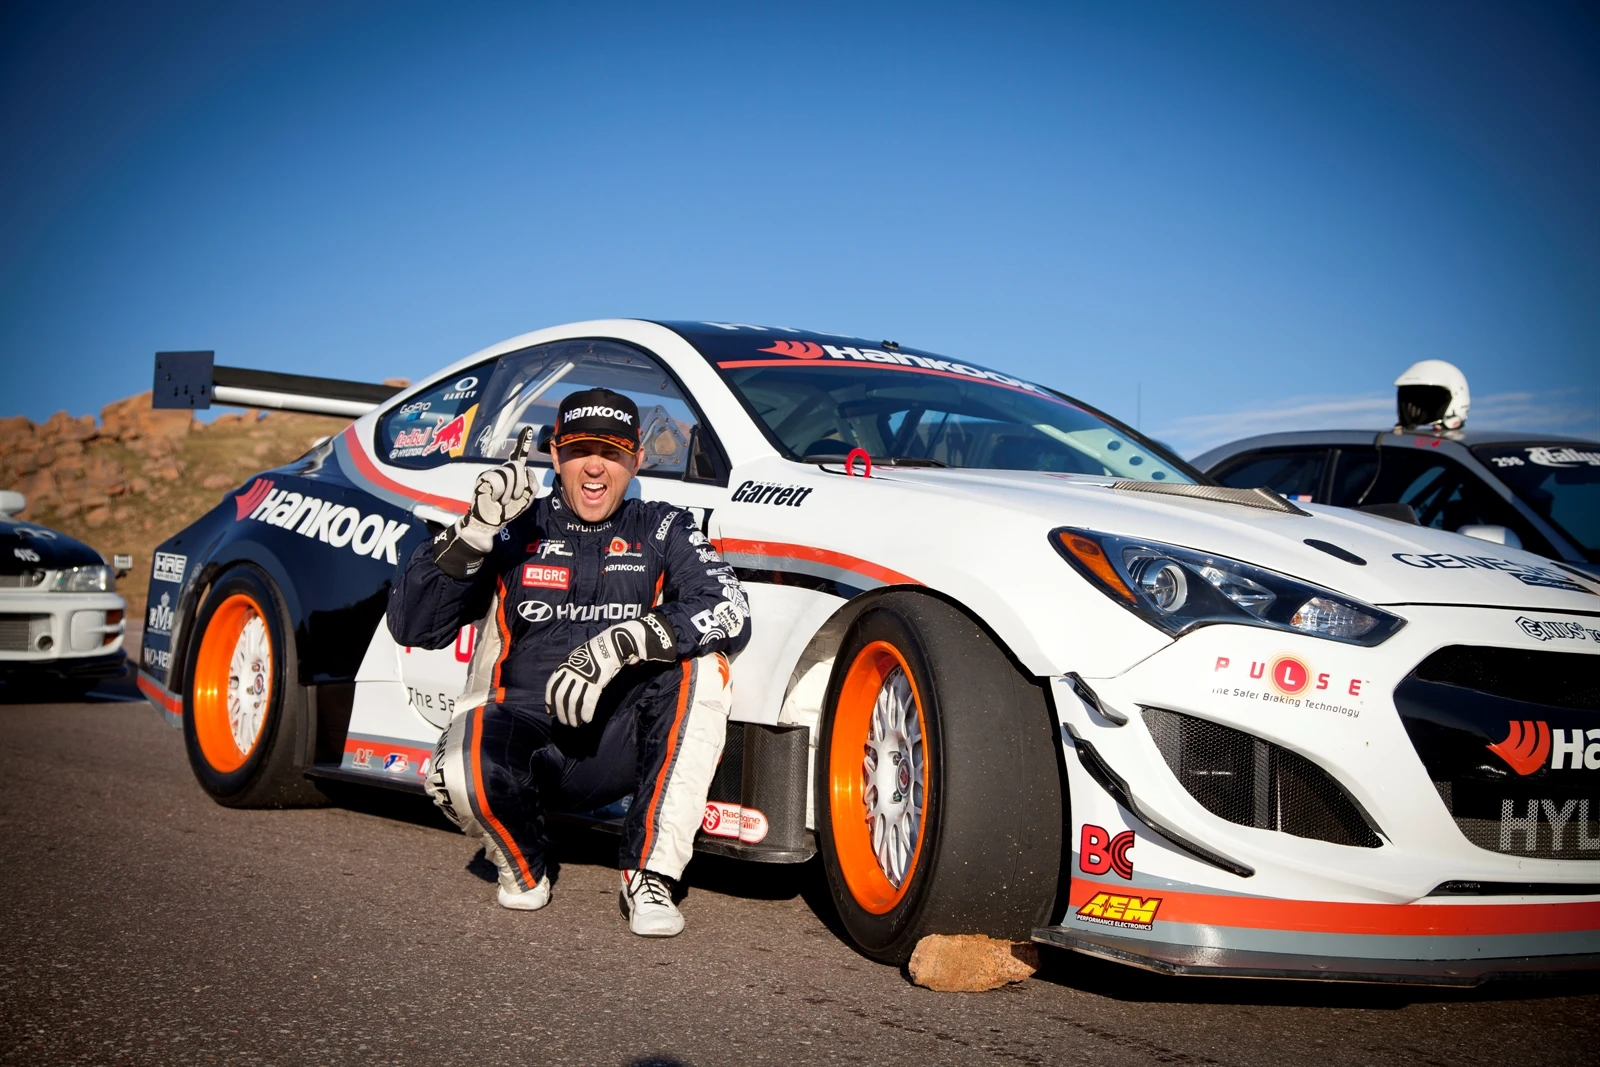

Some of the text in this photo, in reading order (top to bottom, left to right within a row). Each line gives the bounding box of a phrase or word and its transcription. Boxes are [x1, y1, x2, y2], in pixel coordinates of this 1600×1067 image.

[443, 391, 477, 401] OAKLEY
[400, 402, 431, 415] GoPro
[1491, 456, 1525, 467] 298
[731, 480, 813, 507] Garrett
[567, 520, 612, 533] HYUNDAI
[655, 510, 680, 541] sparco
[156, 554, 186, 576] HRE
[543, 568, 567, 582] GRC
[556, 603, 642, 622] HYUNDAI
[719, 611, 734, 631] SPARK
[723, 604, 741, 628] NGK
[641, 612, 673, 650] sparco
[1215, 656, 1362, 696] PULSE
[407, 686, 434, 708] The
[1232, 688, 1260, 700] Safer
[1262, 693, 1301, 707] Braking
[1304, 699, 1360, 718] Technology
[1079, 823, 1136, 881] BC
[1076, 891, 1163, 925] AEM
[1076, 914, 1153, 932] PERFORMANCE ELECTRONICS
